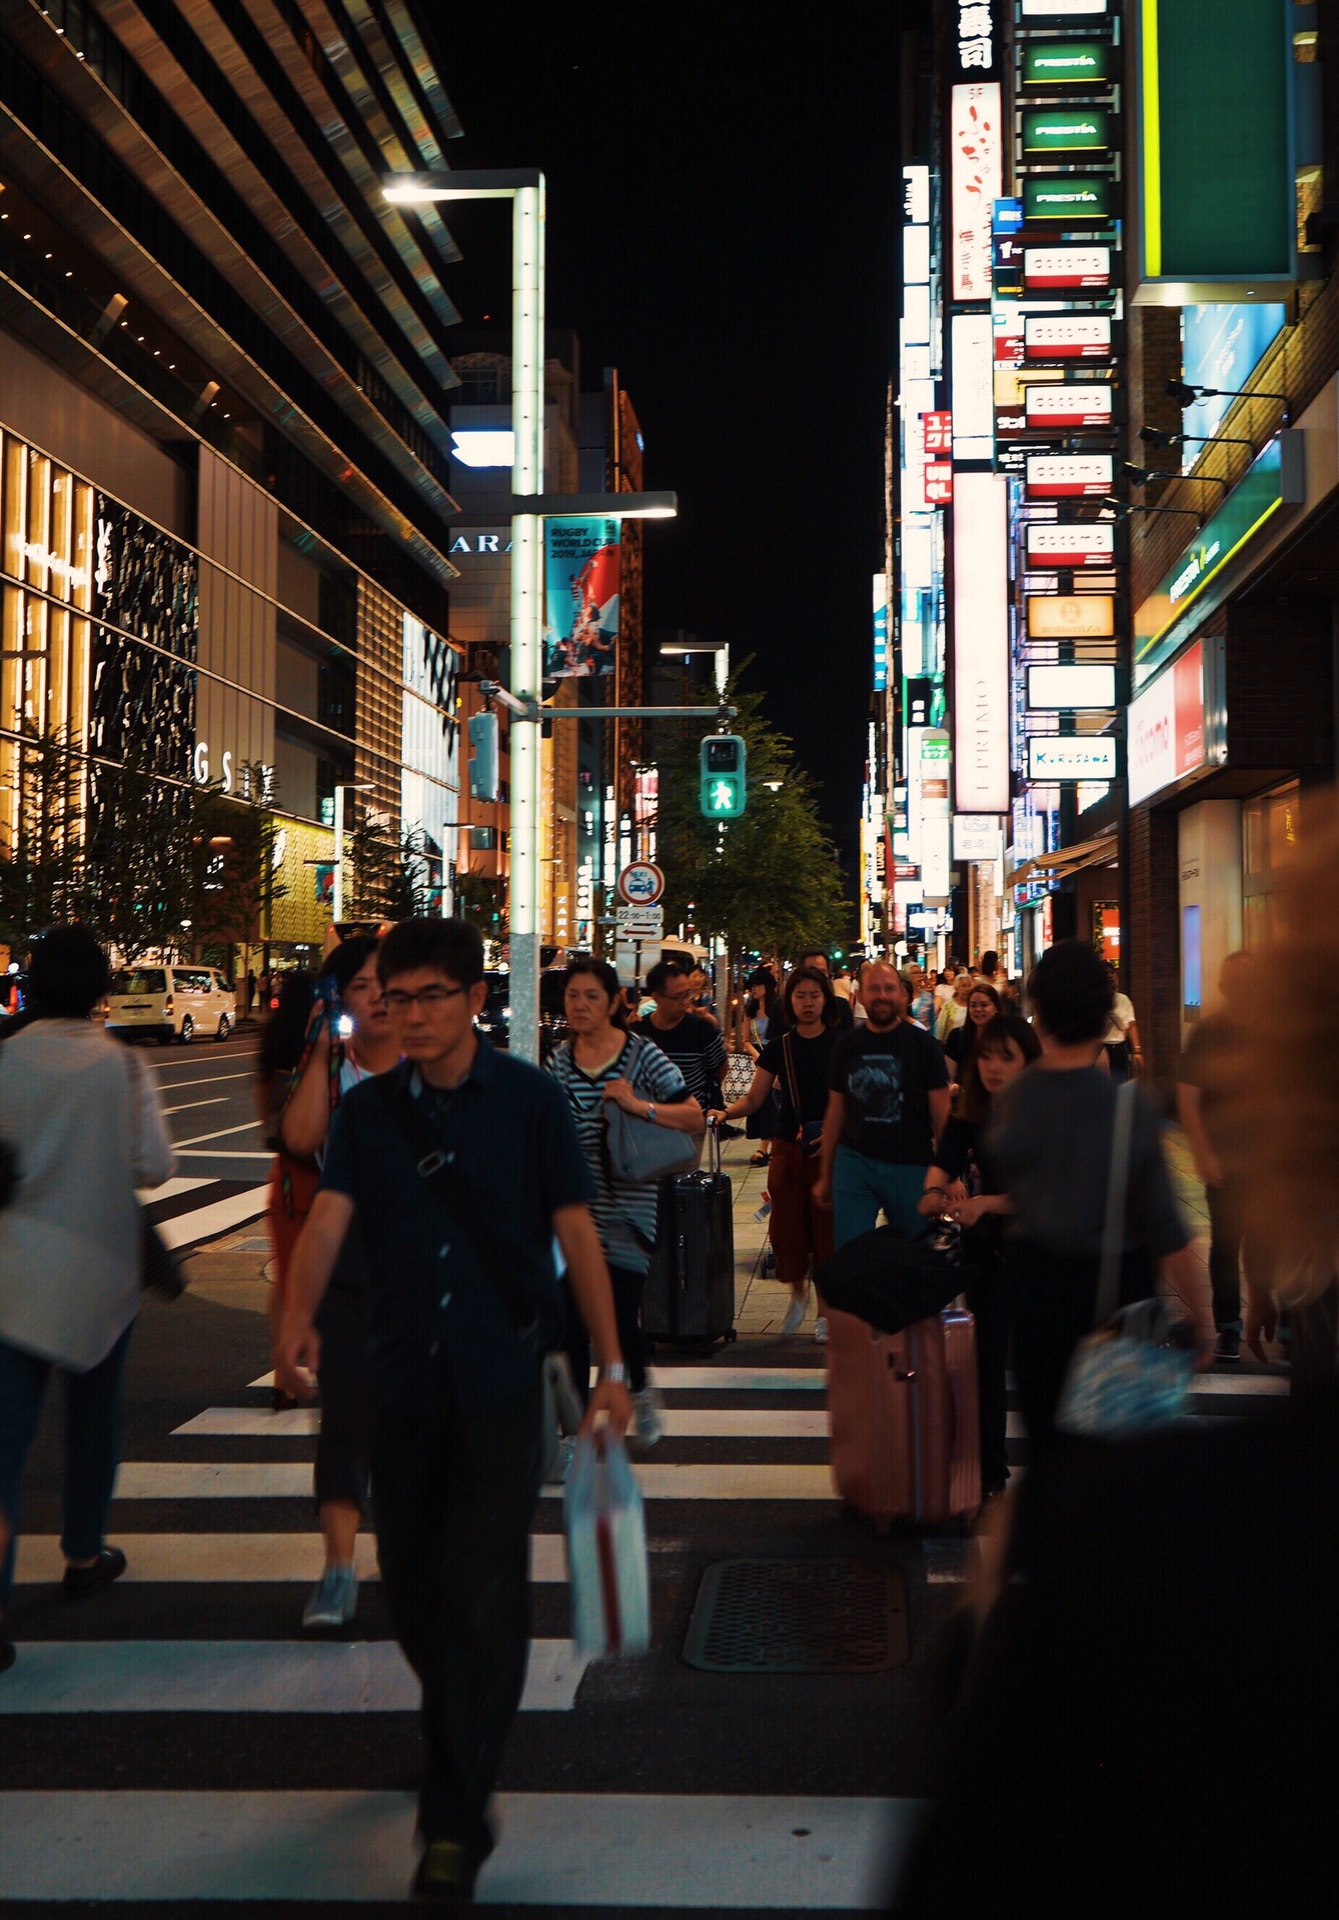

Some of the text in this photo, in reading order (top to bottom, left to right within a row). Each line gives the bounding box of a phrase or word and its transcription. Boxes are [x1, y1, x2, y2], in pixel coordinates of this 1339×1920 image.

[1034, 56, 1096, 67] PRESTIA
[1035, 124, 1097, 135] PRESTIA
[1036, 191, 1097, 202] PRESTIA
[1034, 256, 1101, 269] docomo
[1034, 326, 1102, 339] docomo
[1035, 395, 1103, 408] docomo
[1036, 464, 1104, 477] docomo
[551, 528, 589, 538] RUGBY
[551, 538, 615, 548] WORLD CUP
[1036, 533, 1105, 547] docomo
[975, 680, 991, 790] I-PRIMO
[556, 896, 568, 937] ZARA
